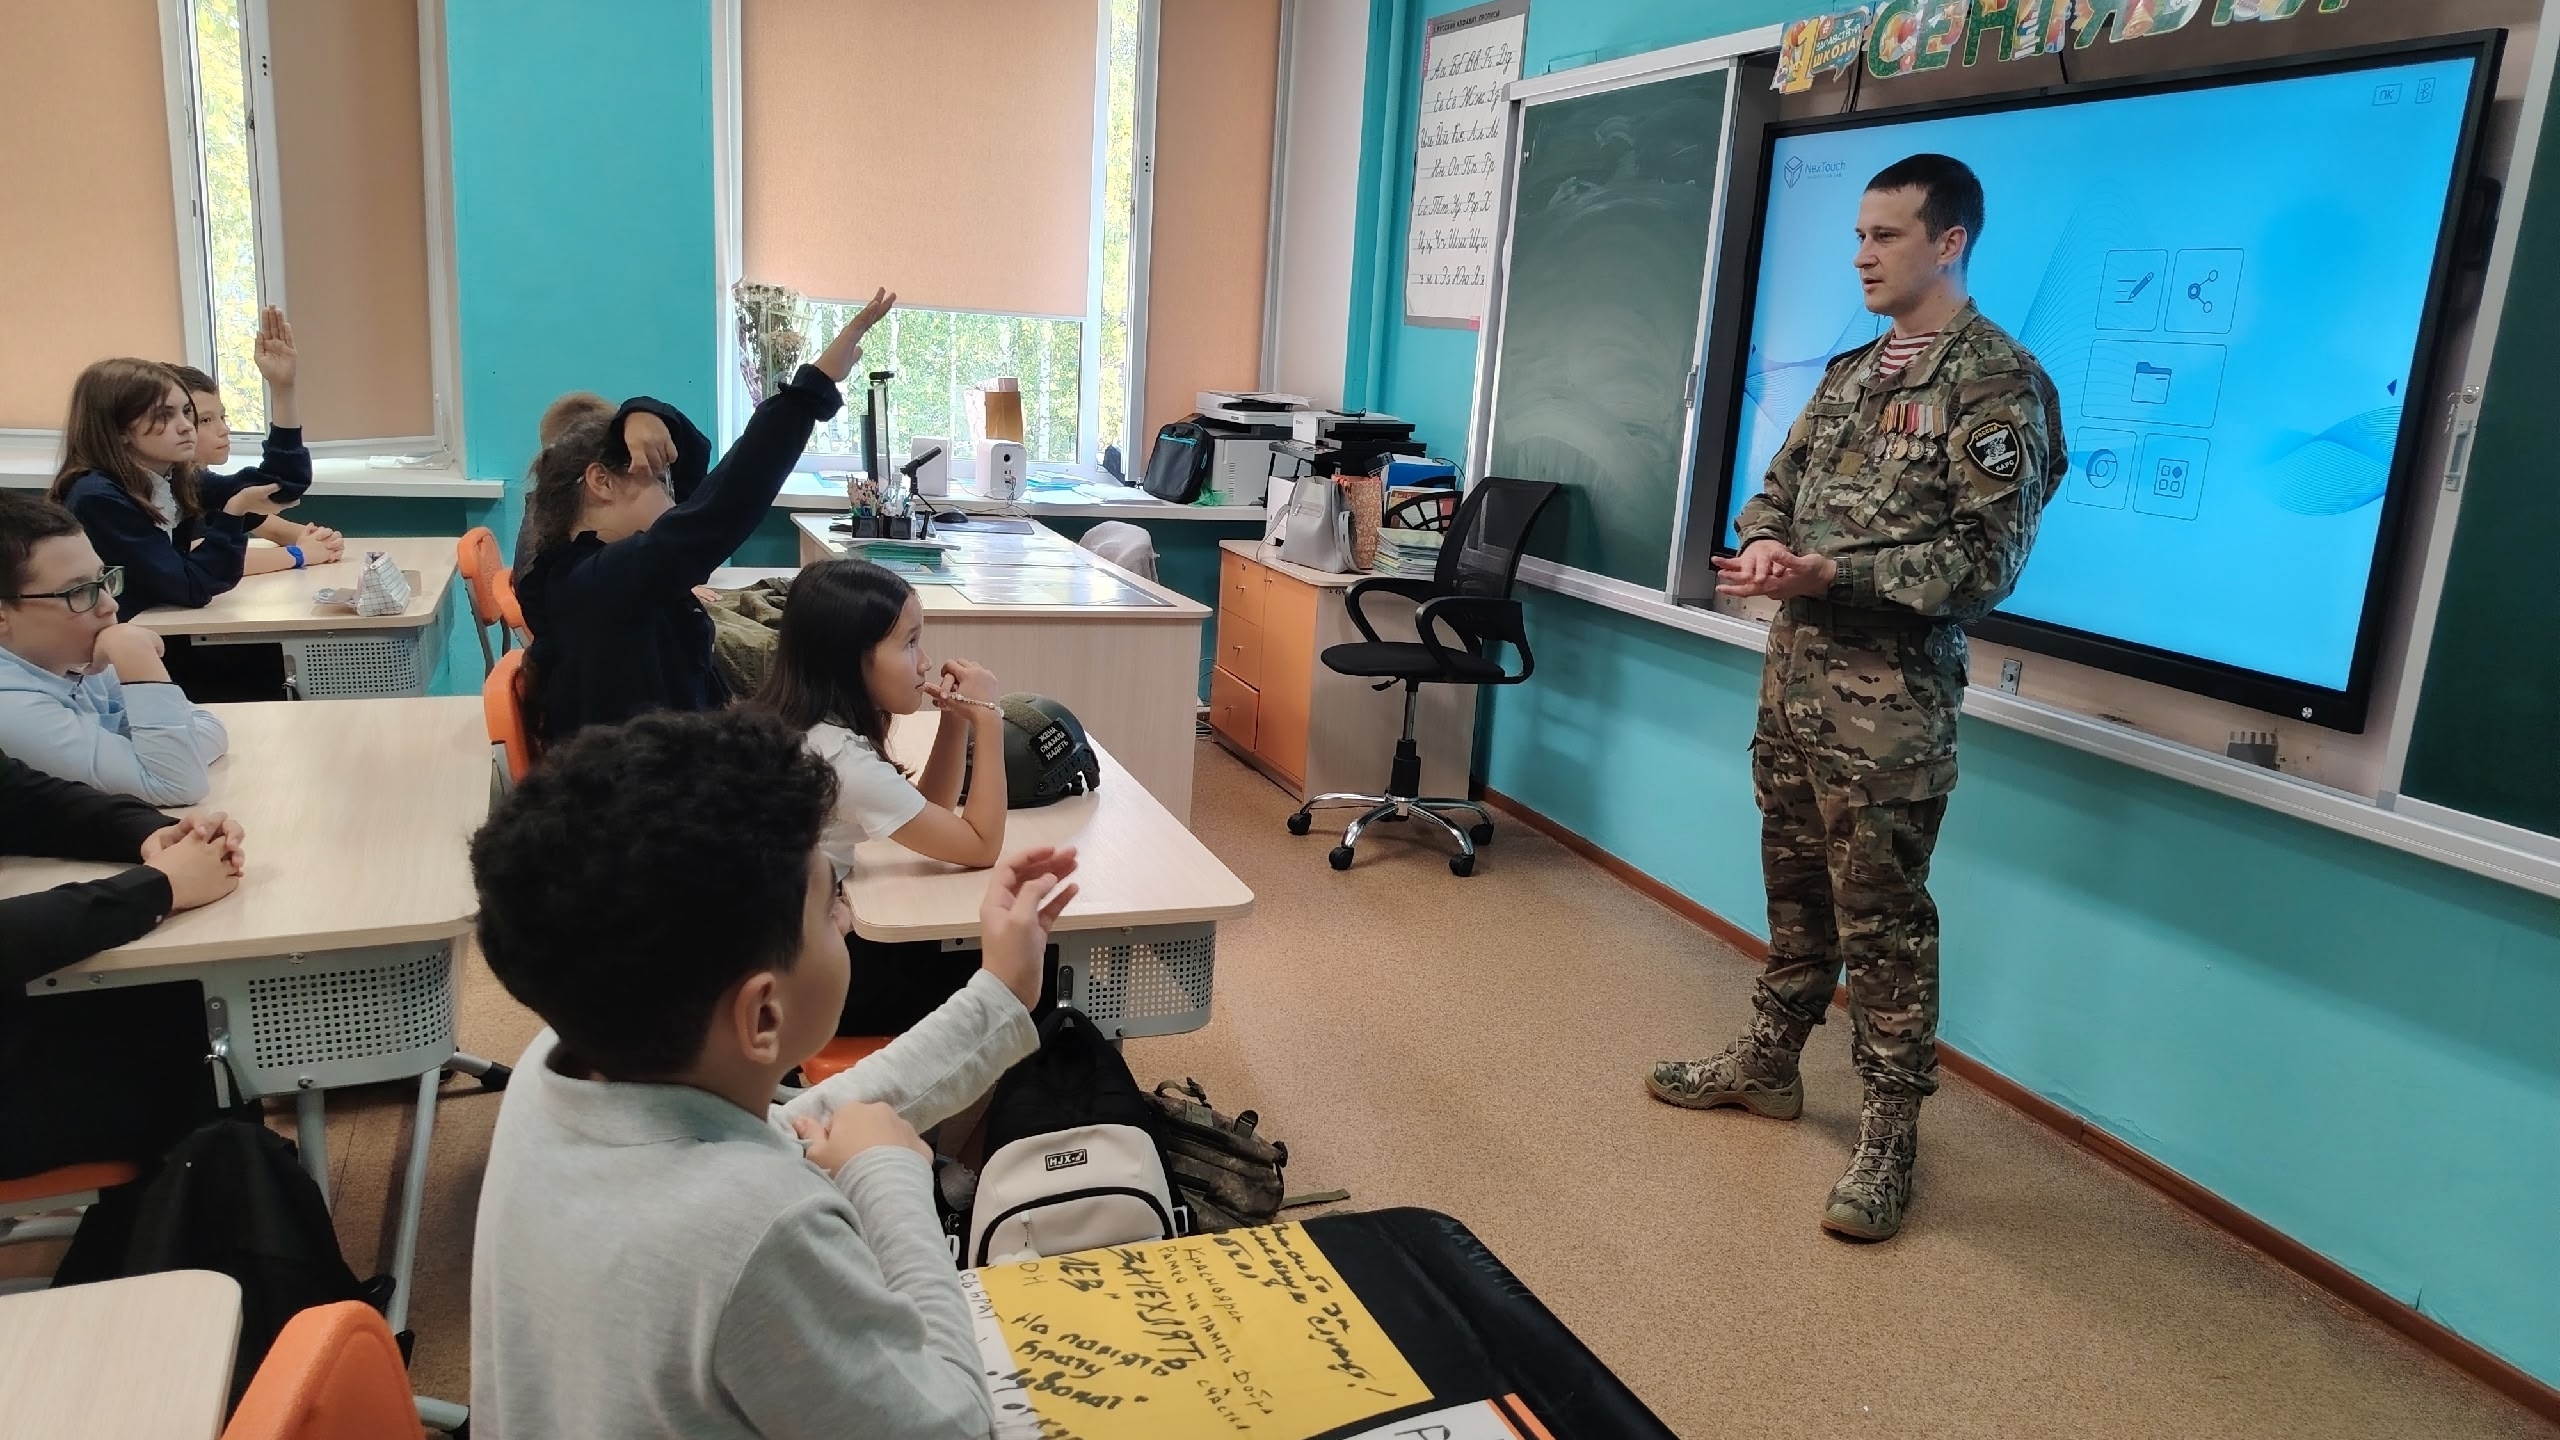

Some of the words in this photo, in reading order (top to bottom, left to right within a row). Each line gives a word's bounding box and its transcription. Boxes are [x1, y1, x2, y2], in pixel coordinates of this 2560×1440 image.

[1804, 160, 1846, 174] NexTouch
[1038, 726, 1059, 743] ЖЕНА
[1040, 731, 1066, 753] СКАЗАЛА
[1045, 740, 1069, 760] НАДЕТЬ
